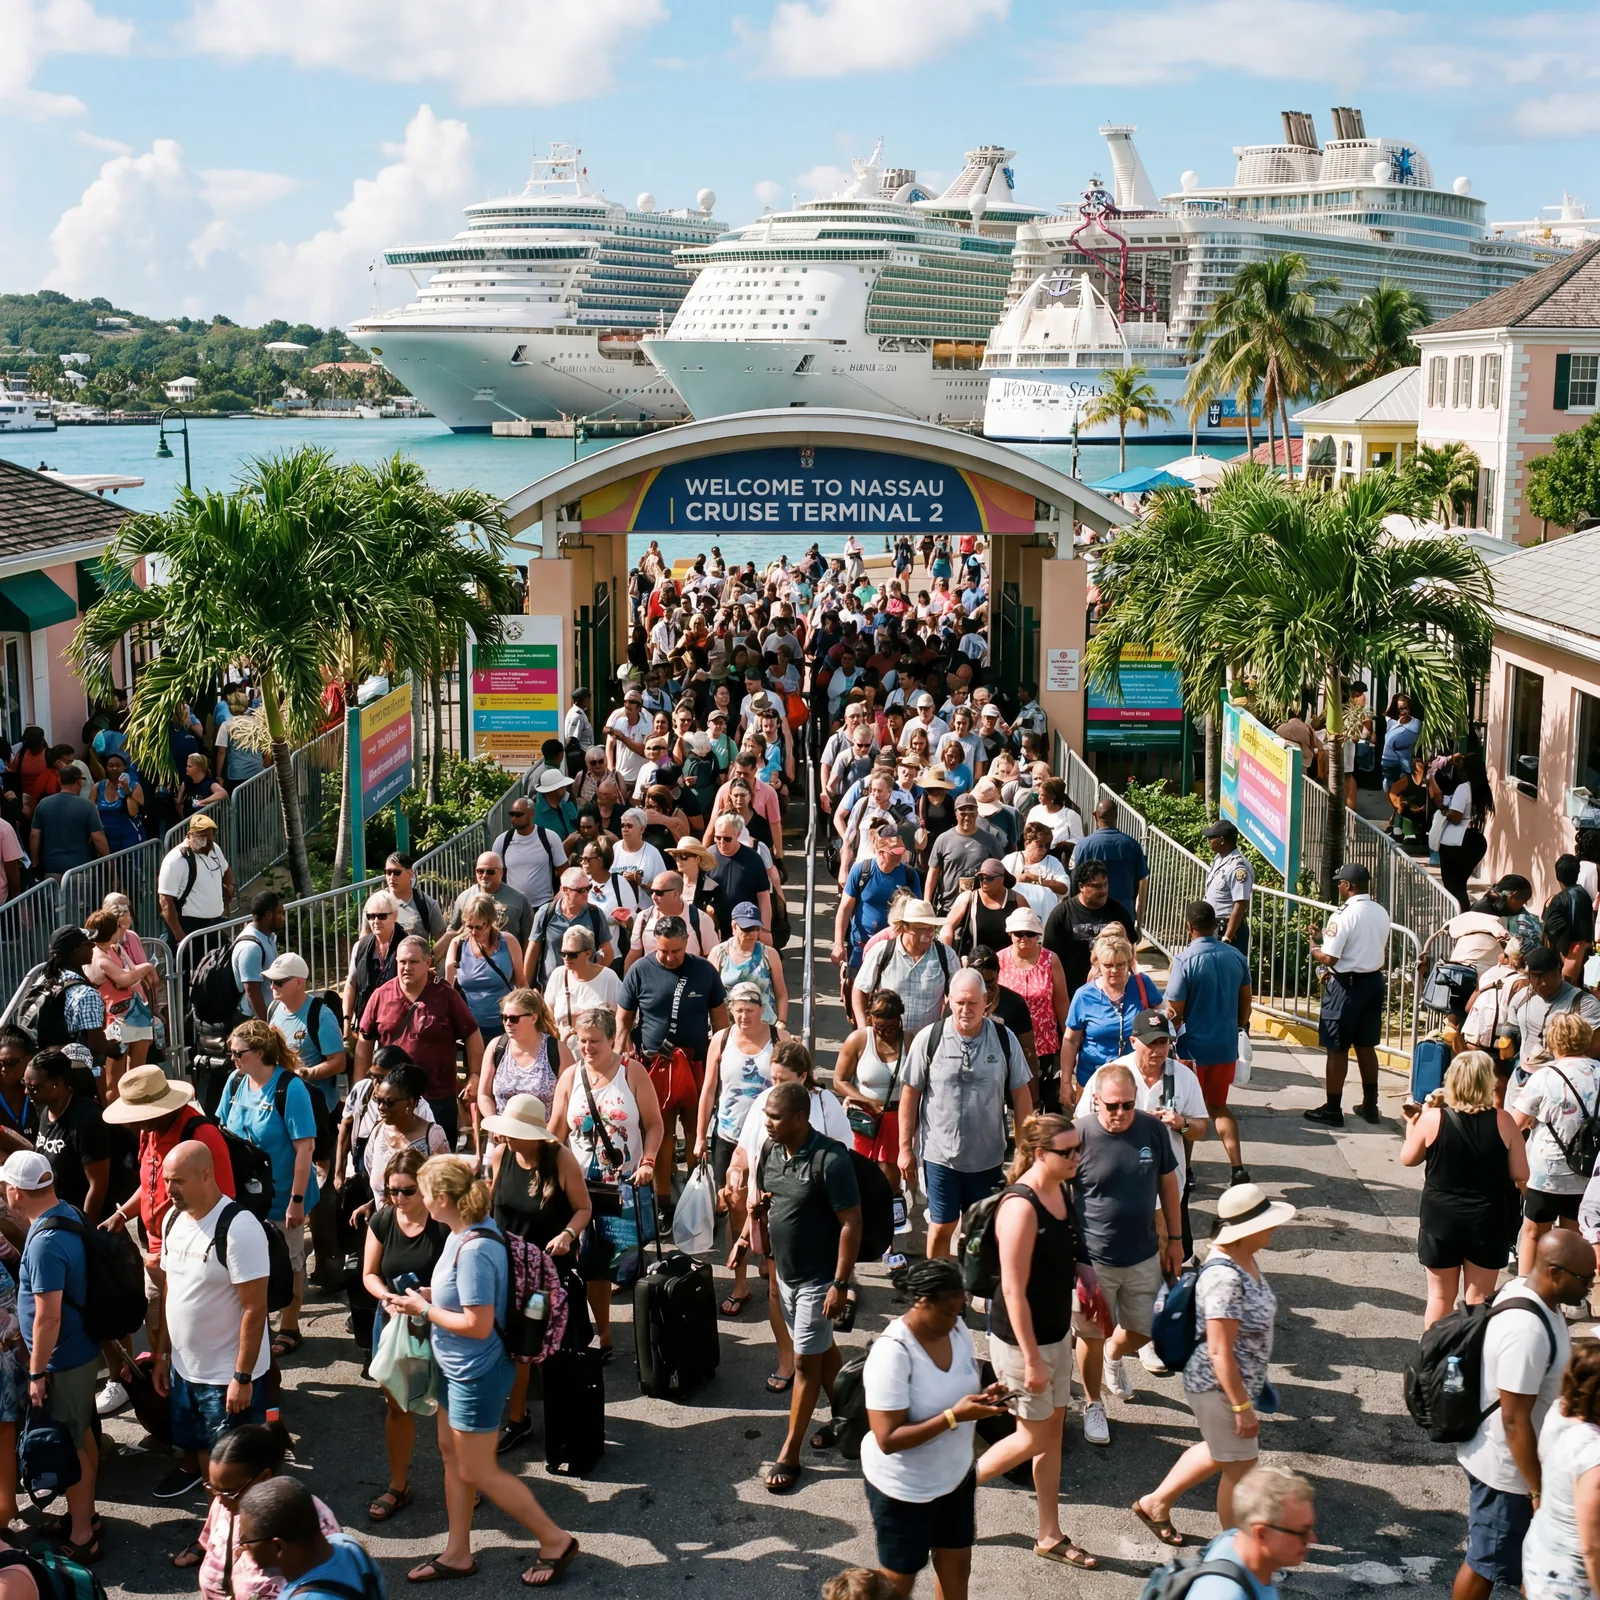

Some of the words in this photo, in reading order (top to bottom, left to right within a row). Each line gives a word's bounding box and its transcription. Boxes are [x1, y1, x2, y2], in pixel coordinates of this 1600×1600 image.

[1003, 381, 1052, 398] WONDER
[1066, 381, 1105, 399] SEAS
[685, 479, 803, 496] WELCOME
[811, 479, 843, 496] TO
[850, 479, 944, 497] NASSAU
[685, 502, 780, 522] CRUISE
[787, 502, 921, 522] TERMINAL
[929, 502, 943, 522] 2
